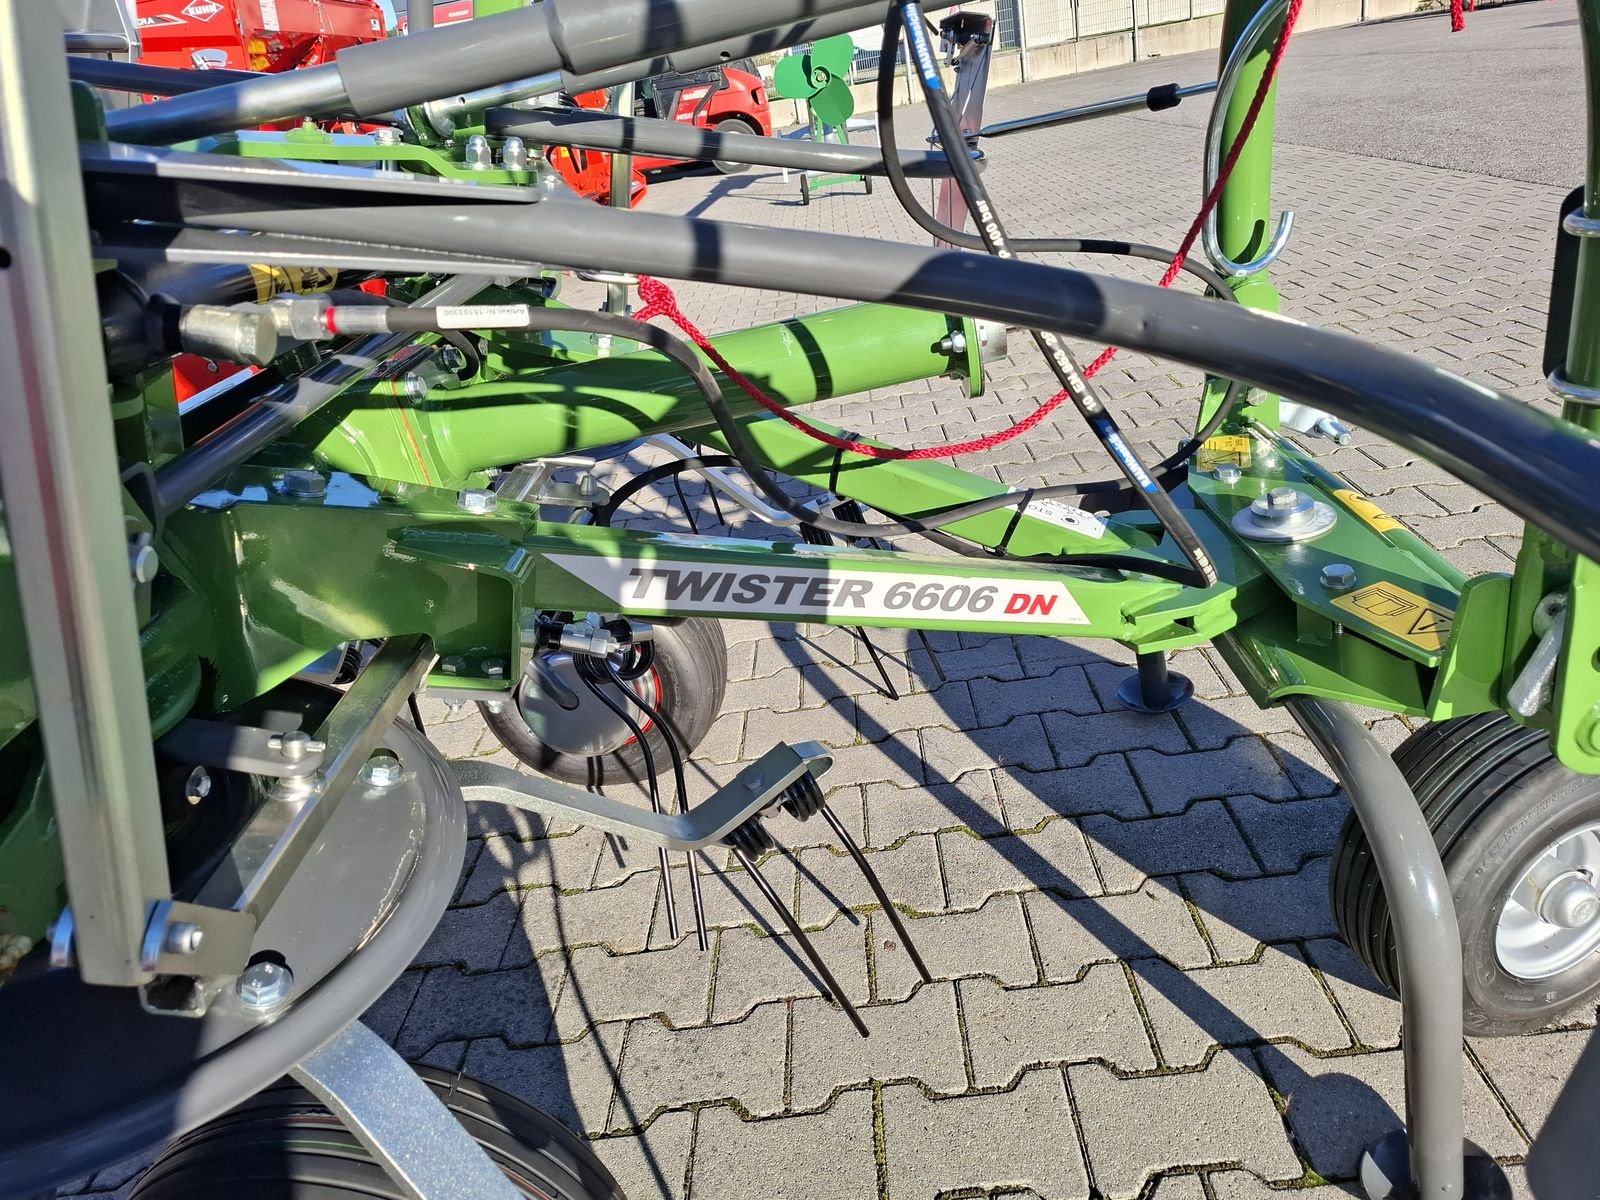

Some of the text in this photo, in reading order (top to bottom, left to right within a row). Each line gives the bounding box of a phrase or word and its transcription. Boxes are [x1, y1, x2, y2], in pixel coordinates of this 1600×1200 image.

[188, 4, 218, 15] KUHN
[975, 200, 993, 223] bar
[986, 222, 1004, 246] 400
[1053, 349, 1073, 374] 853
[1067, 372, 1086, 393] EN
[1082, 395, 1097, 411] 10
[629, 568, 1058, 615] TWISTER 6606 DN
